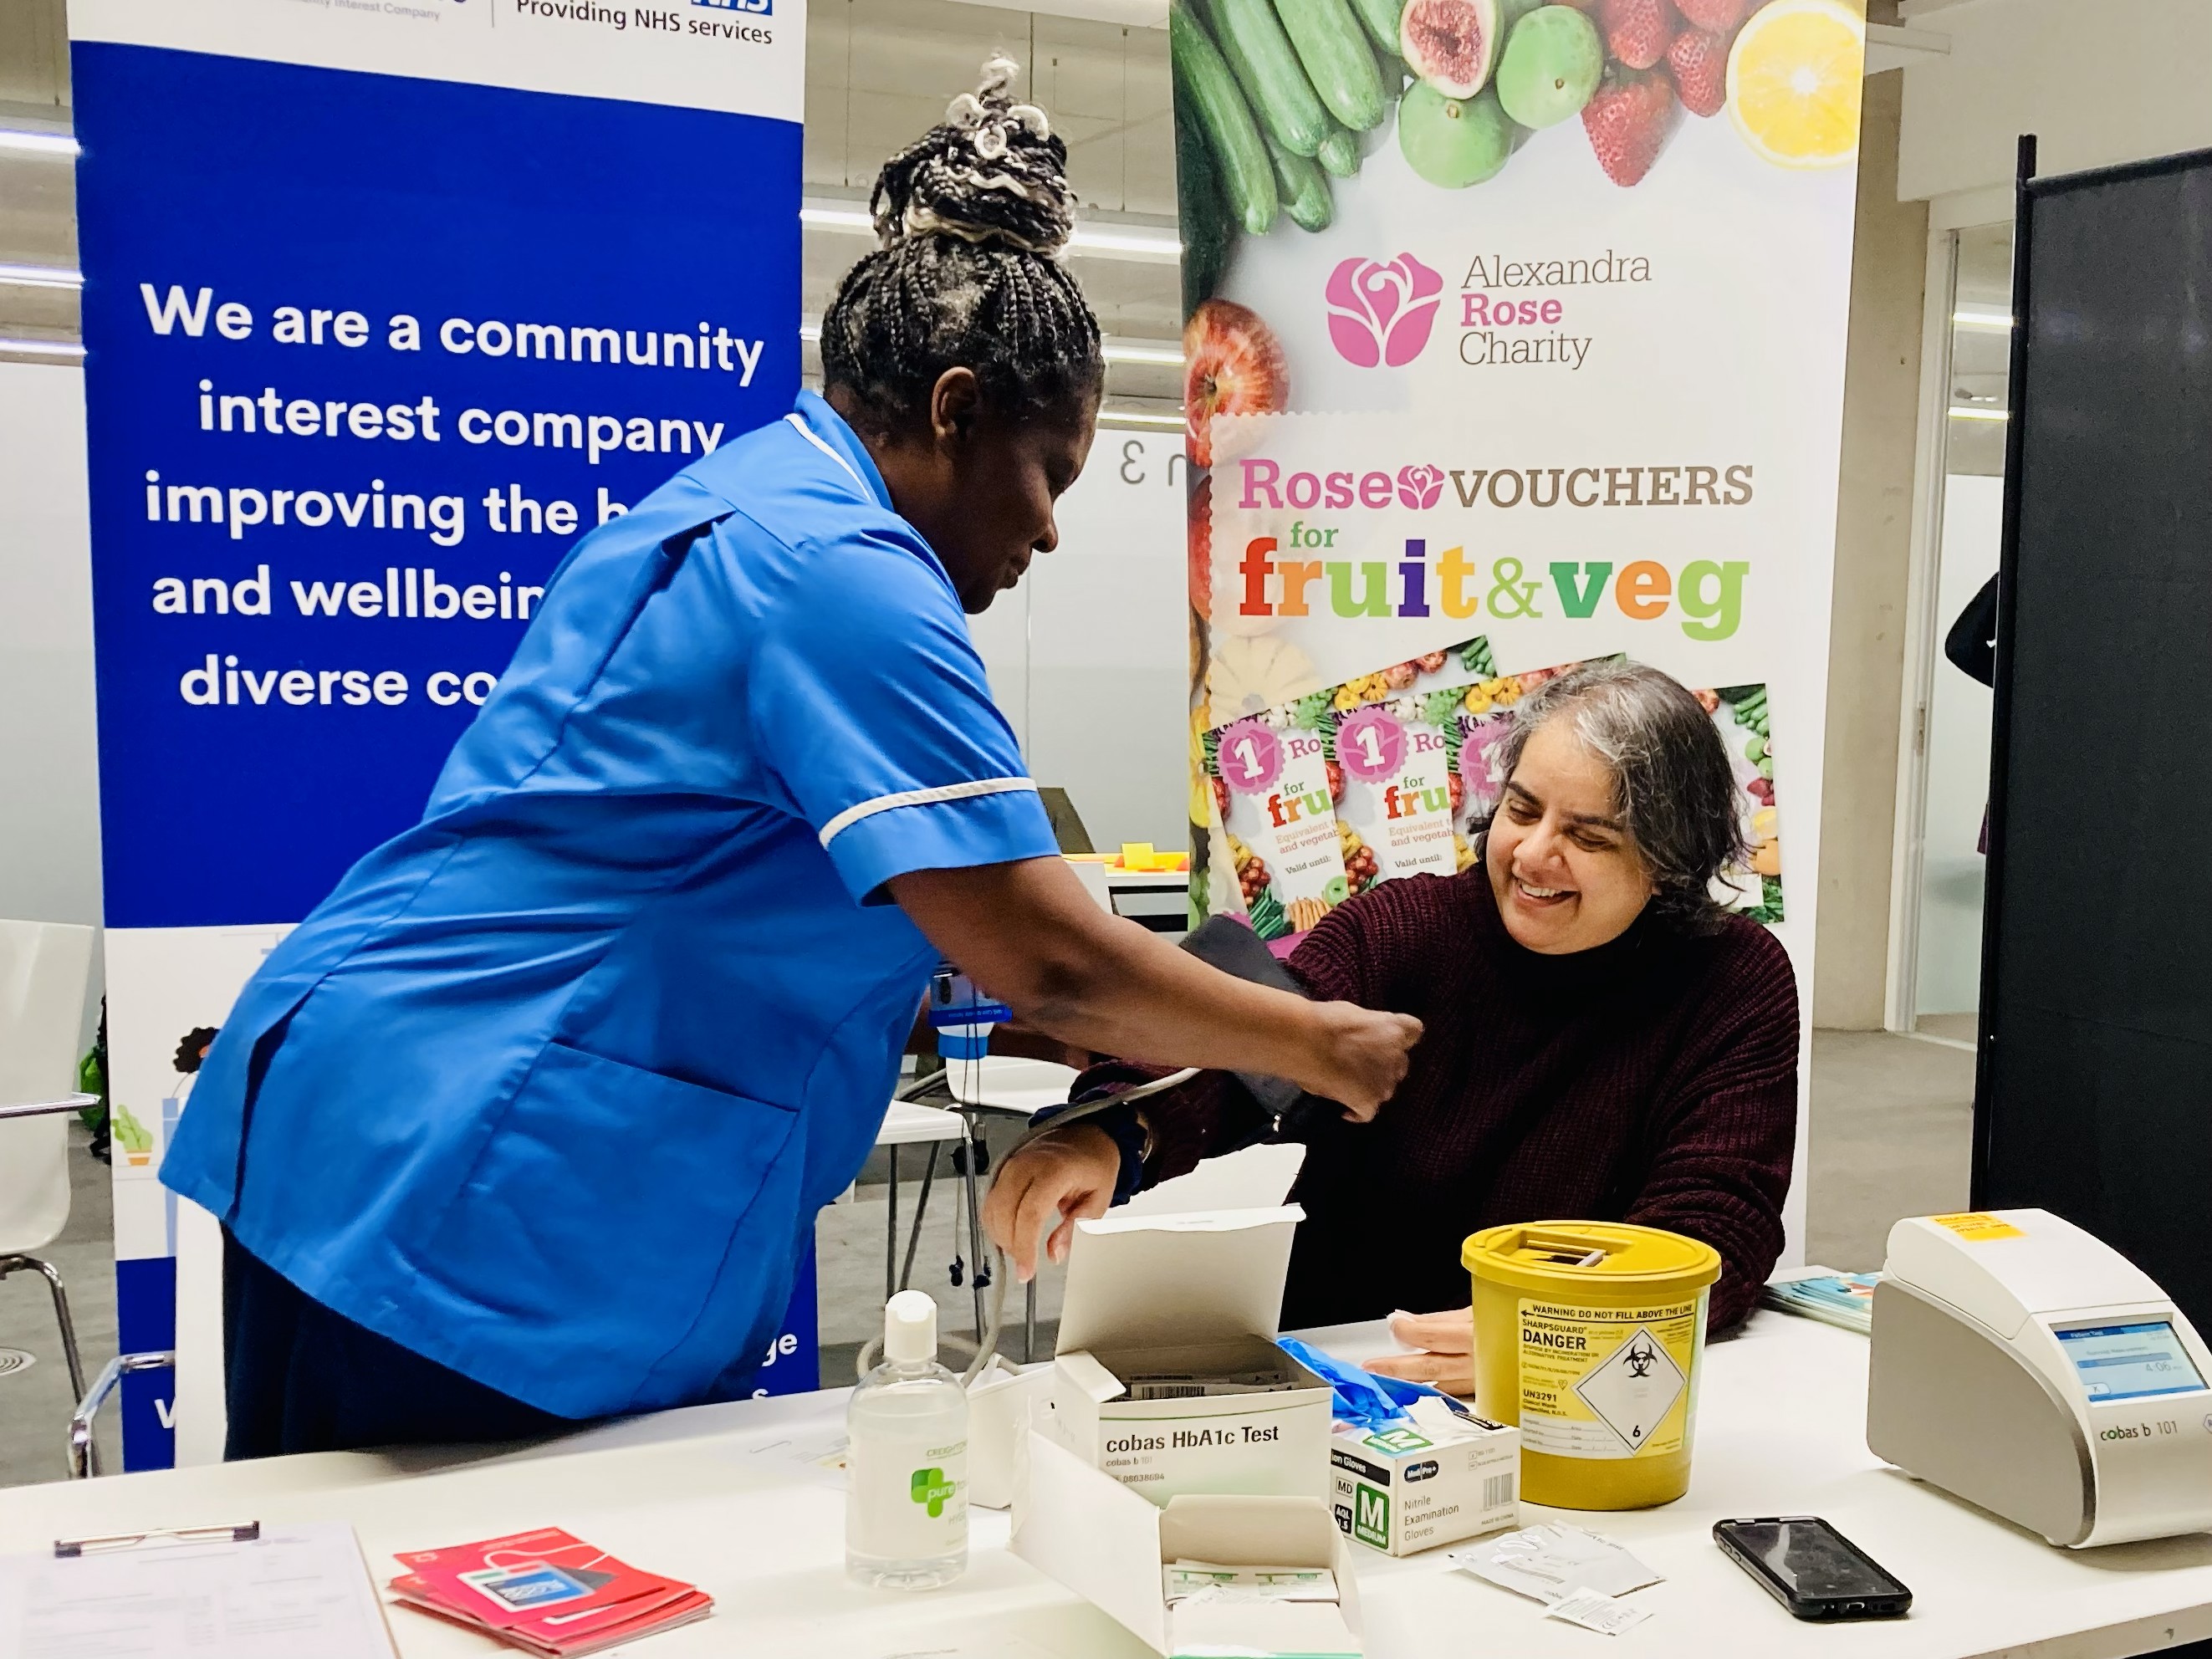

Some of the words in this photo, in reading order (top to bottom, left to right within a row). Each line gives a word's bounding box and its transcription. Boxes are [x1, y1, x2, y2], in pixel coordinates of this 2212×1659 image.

[384, 3, 441, 21] Company
[517, 0, 626, 29] Providing
[636, 9, 680, 31] NHS
[689, 21, 772, 43] services
[1461, 250, 1652, 289] Alexandra
[1461, 293, 1562, 327] Rose
[140, 283, 253, 340] We
[273, 306, 370, 347] are
[389, 314, 421, 351] a
[441, 319, 764, 386] community
[1460, 331, 1593, 370] Charity
[199, 380, 441, 442] interest
[458, 408, 725, 463] company
[1239, 458, 1393, 511] Rose
[1449, 465, 1753, 508] VOUCHERS
[146, 469, 465, 547] improving
[483, 483, 579, 535] the
[1290, 521, 1339, 549] for
[152, 564, 271, 615] and
[180, 655, 409, 706] diverse
[1355, 727, 1385, 768] 1
[1234, 738, 1264, 779] 1
[1284, 780, 1305, 796] for
[1402, 775, 1425, 789] for
[1280, 841, 1298, 854] and
[1391, 835, 1411, 846] and
[1285, 862, 1307, 875] Valid
[1395, 857, 1418, 868] Valid
[1533, 1304, 1576, 1317] WARNING
[1616, 1311, 1634, 1320] FILL
[1636, 1309, 1663, 1319] ABOVE
[1665, 1307, 1678, 1316] THE
[1523, 1328, 1586, 1350] DANGER
[1523, 1388, 1557, 1402] UN3291
[1106, 1435, 1165, 1452] cobas
[1172, 1429, 1235, 1448] HbA1c
[1241, 1426, 1279, 1443] Test
[1632, 1425, 1641, 1437] 6
[2100, 1425, 2139, 1441] cobas
[2142, 1423, 2152, 1437] b
[2157, 1420, 2178, 1435] 101
[1106, 1457, 1131, 1467] cobas
[1343, 1456, 1367, 1473] Gloves
[1338, 1479, 1352, 1494] MD
[1360, 1489, 1385, 1532] M
[1404, 1495, 1431, 1511] Nitrile
[1404, 1504, 1460, 1526] Examination
[1356, 1524, 1387, 1545] MEDIUM
[1404, 1526, 1435, 1541] Gloves
